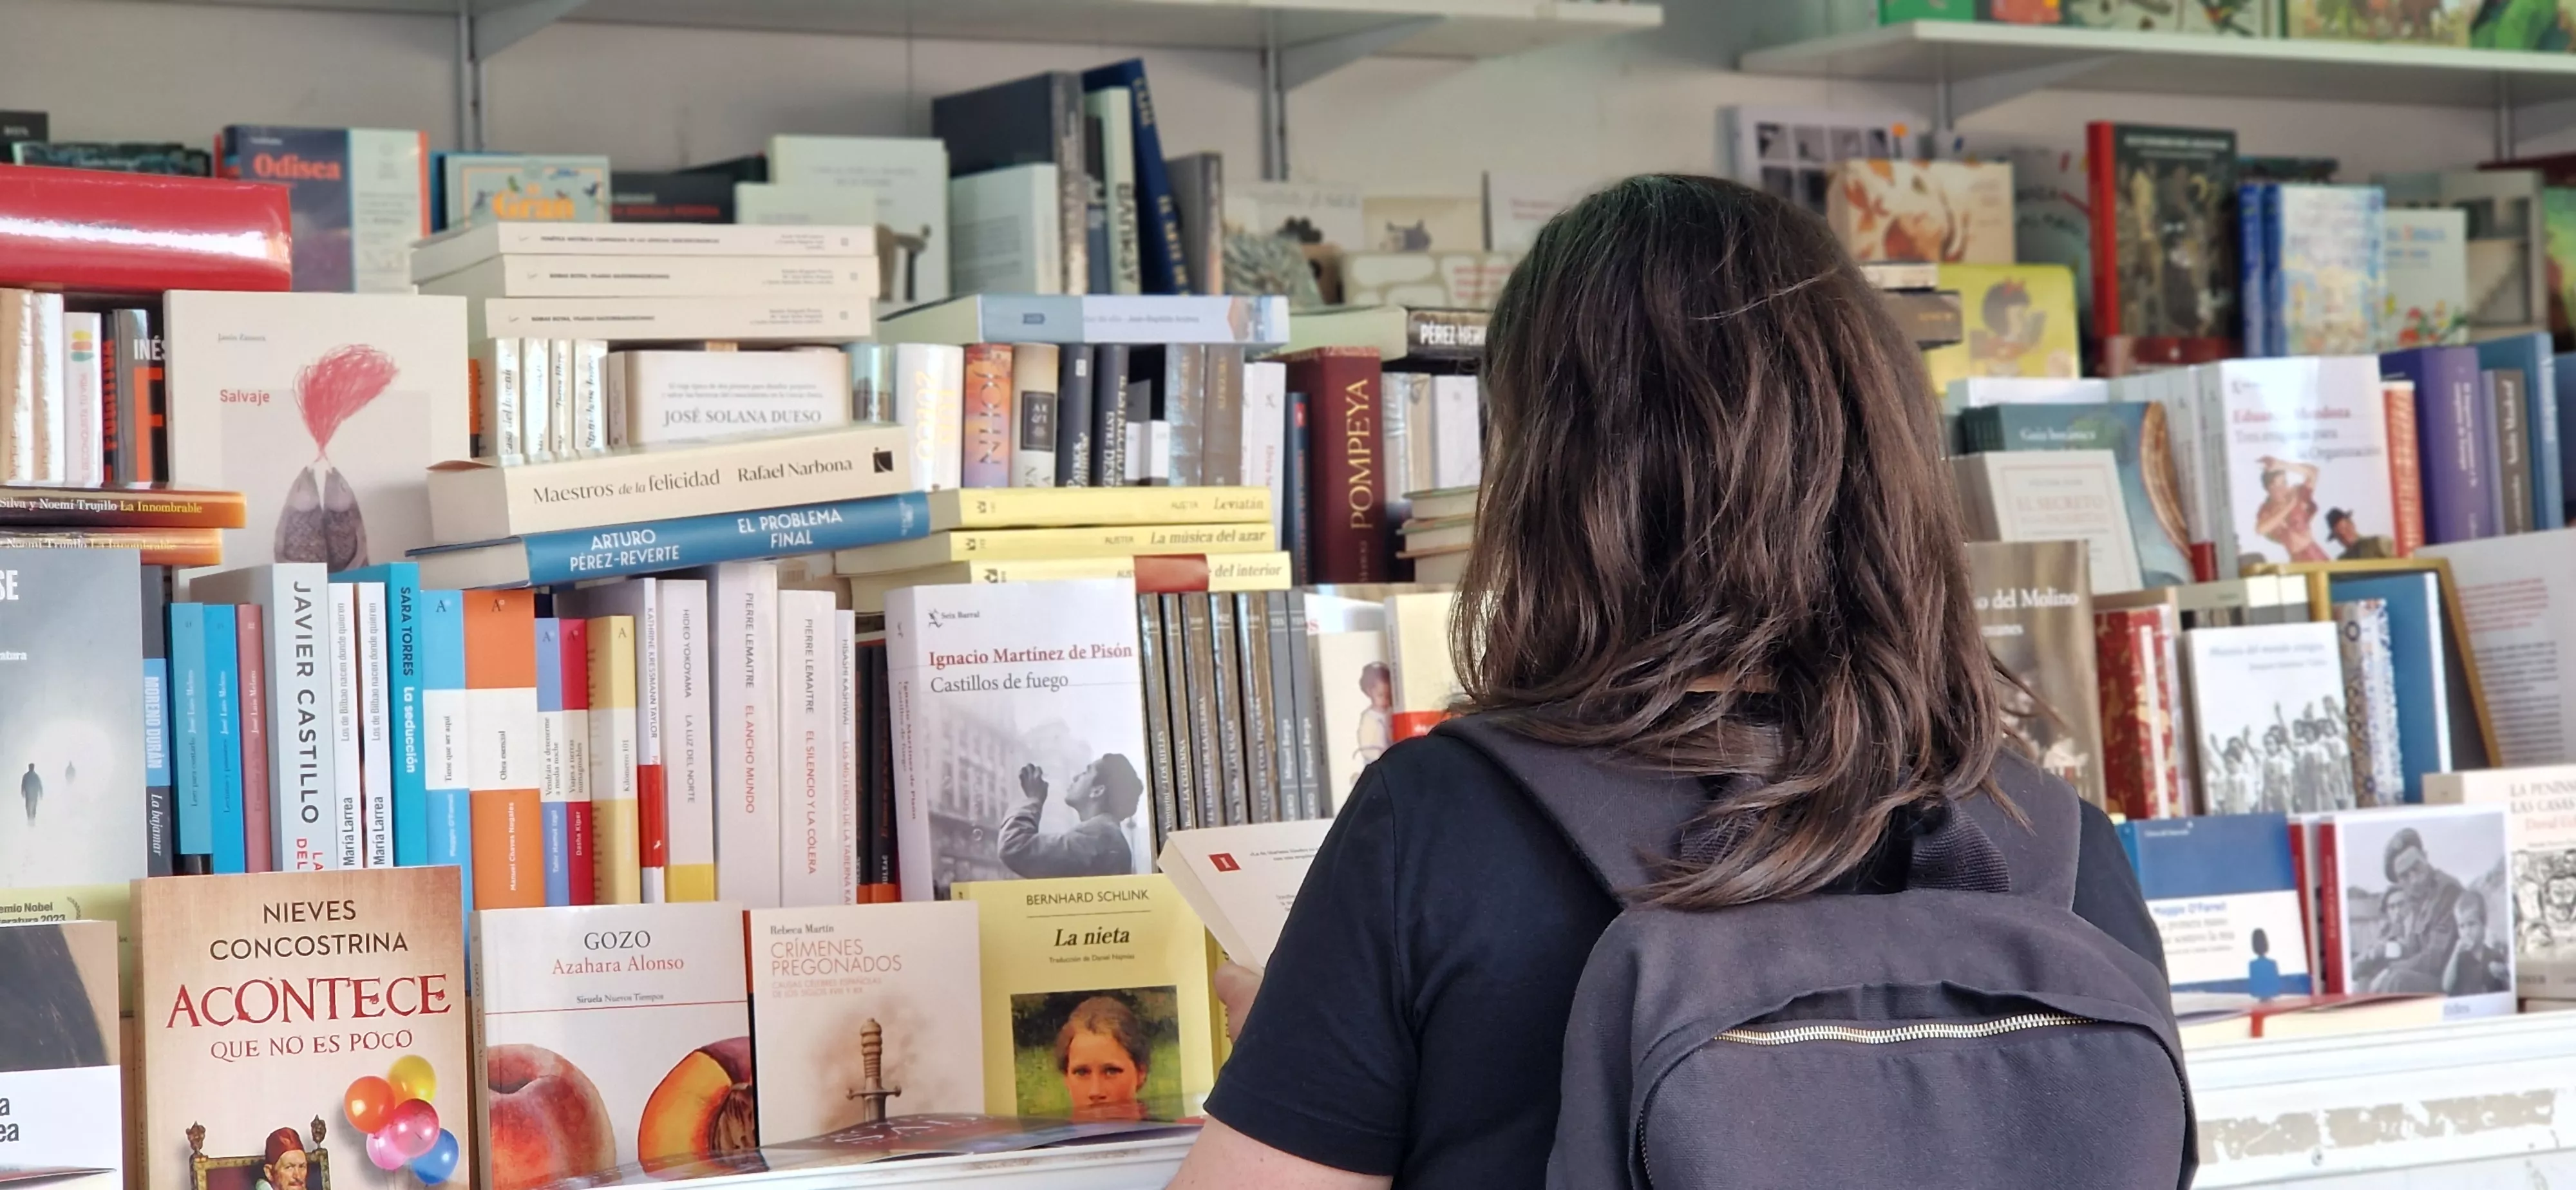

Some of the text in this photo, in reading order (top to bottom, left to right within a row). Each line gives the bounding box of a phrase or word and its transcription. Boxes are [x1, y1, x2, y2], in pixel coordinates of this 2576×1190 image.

[220, 389, 270, 406] Salvaje
[662, 407, 822, 428] JOSÉ SOLANA DUESO
[972, 372, 1002, 465] JOHN
[1346, 379, 1374, 529] POMPEYA
[737, 457, 853, 483] Rafael Narbona
[533, 469, 720, 505] Maestros de la felicidad
[0, 497, 202, 513] Silva y Noemí Trujillo La Innombrable
[1213, 496, 1264, 511] Leviatán
[738, 509, 843, 534] EL PROBLEMA
[591, 529, 656, 551] ARTURO
[770, 529, 813, 548] FINAL
[1150, 529, 1266, 544] La música del azar
[570, 545, 680, 572] PÉREZ-REVERTE
[1215, 564, 1282, 578] del interior
[1992, 588, 2016, 609] del
[2020, 587, 2079, 607] Molino
[337, 603, 347, 634] quieren
[400, 587, 413, 676] SARA TORRES
[337, 636, 346, 660] donde
[682, 609, 692, 697] HIDEO YOKOYAMA
[745, 593, 755, 688] PIERRE LEMAITRE
[804, 618, 814, 713] PIERRE LEMAITRE
[929, 643, 1133, 670] Ignacio Martínez de Pisón
[368, 603, 381, 741] Los de Bilbao nacen donde quieren
[648, 652, 656, 704] KRESSMANN
[931, 672, 1069, 694] Castillos de fuego
[294, 581, 319, 824] JAVIER CASTILLO
[339, 689, 348, 714] Bilbao
[144, 676, 163, 769] MORENO DURÁN
[341, 716, 349, 726] de
[341, 728, 350, 741] Los
[404, 686, 418, 773] La seducción
[650, 706, 658, 738] TAYLOR
[685, 715, 693, 728] LA
[1282, 719, 1291, 746] Berga
[1303, 717, 1312, 744] Berga
[498, 731, 506, 759] esencial
[806, 730, 815, 743] EL
[1157, 731, 1166, 764] RIELES
[745, 705, 755, 813] EL ANCHO MUNDO
[806, 746, 815, 798] SILENCIO
[544, 766, 553, 796] Vendrán
[569, 772, 577, 793] Viajes
[621, 754, 630, 792] Kilómetro
[687, 770, 696, 804] NORTE
[806, 811, 815, 826] LA
[2510, 797, 2575, 815] LAS CASAS
[149, 793, 163, 856] La bajamar
[342, 797, 355, 865] María Larrea
[372, 797, 385, 865] María Larrea
[574, 811, 583, 832] Kiper
[296, 837, 307, 871] DEL
[806, 829, 818, 874] CÓLERA
[843, 844, 851, 887] TABERNA
[24, 902, 53, 912] Nobel
[1026, 889, 1149, 906] BERNHARD SCHLINK
[262, 900, 357, 924] NIEVES
[583, 930, 651, 950] GOZO
[770, 924, 834, 934] Rebeca Martín
[1054, 925, 1130, 946] La nieta
[209, 931, 409, 961] CONCOSTRINA
[771, 938, 863, 958] CRÍMENES
[552, 955, 684, 976] Azahara Alonso
[772, 955, 902, 976] PREGONADOS
[166, 974, 451, 1029] ACONTECE
[576, 992, 664, 1003] Siruela Nuevos Tiempos
[210, 1029, 413, 1062] QUE NO ES POCO
